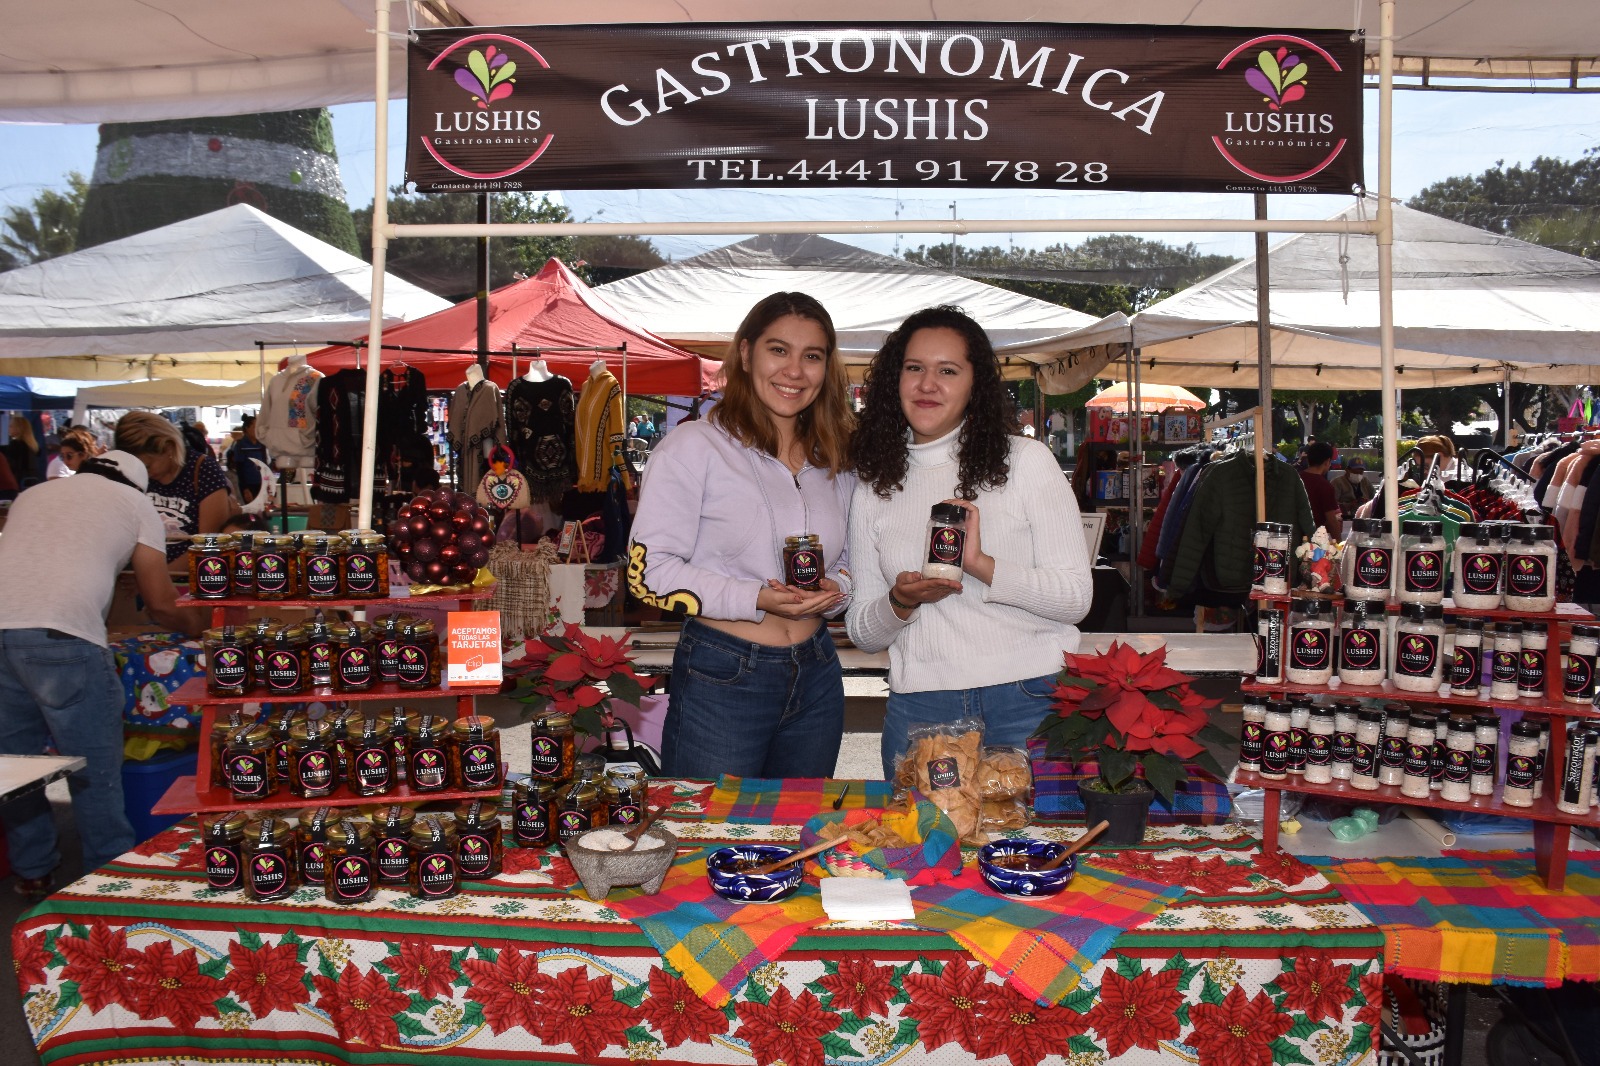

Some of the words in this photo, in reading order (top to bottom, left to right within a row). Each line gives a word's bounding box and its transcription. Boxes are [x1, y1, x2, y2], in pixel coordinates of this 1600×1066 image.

[600, 31, 1166, 135] GASTRONOMICA
[434, 110, 541, 132] LUSHIS
[805, 98, 989, 141] LUSHIS
[1224, 111, 1334, 134] LUSHIS
[434, 136, 539, 145] Gastronómica
[1225, 137, 1331, 147] Gastronómica
[915, 160, 968, 181] 91
[986, 160, 1040, 182] 78
[1055, 161, 1109, 183] 28
[472, 182, 488, 190] 444
[503, 181, 523, 189] 7828
[1360, 566, 1387, 574] LUSHIS
[309, 574, 337, 582] LUSHIS
[451, 627, 497, 635] ACEPTAMOS
[1268, 616, 1277, 660] Sazonador
[451, 640, 497, 649] TARJETAS
[1401, 652, 1430, 662] LUSHIS
[310, 661, 330, 669] USH
[343, 665, 370, 673] LUSHIS
[398, 663, 425, 671] LUSHIS
[215, 666, 245, 675] LUSHIS
[1453, 666, 1470, 674] SHIS
[1567, 674, 1586, 682] SHIS
[1265, 750, 1288, 758] LUSHI
[1287, 747, 1307, 755] SHIS
[1308, 747, 1329, 755] LUSHIS
[531, 755, 557, 763] LUSHIS
[1567, 735, 1581, 782] Sazonador
[360, 766, 388, 776] LUSHIS
[415, 766, 445, 775] LUSHIS
[464, 762, 496, 773] LUSHIS
[232, 774, 262, 782] LUSHIS
[302, 769, 331, 779] LUSHIS
[517, 820, 545, 828] LUSHIS
[379, 857, 409, 865] LUSHIS
[460, 854, 489, 862] LUSHIS
[206, 866, 235, 874] LUSHIS
[253, 872, 283, 882] LUSHIS
[337, 876, 369, 886] LUSHIS
[422, 873, 453, 883] LUSHIS
